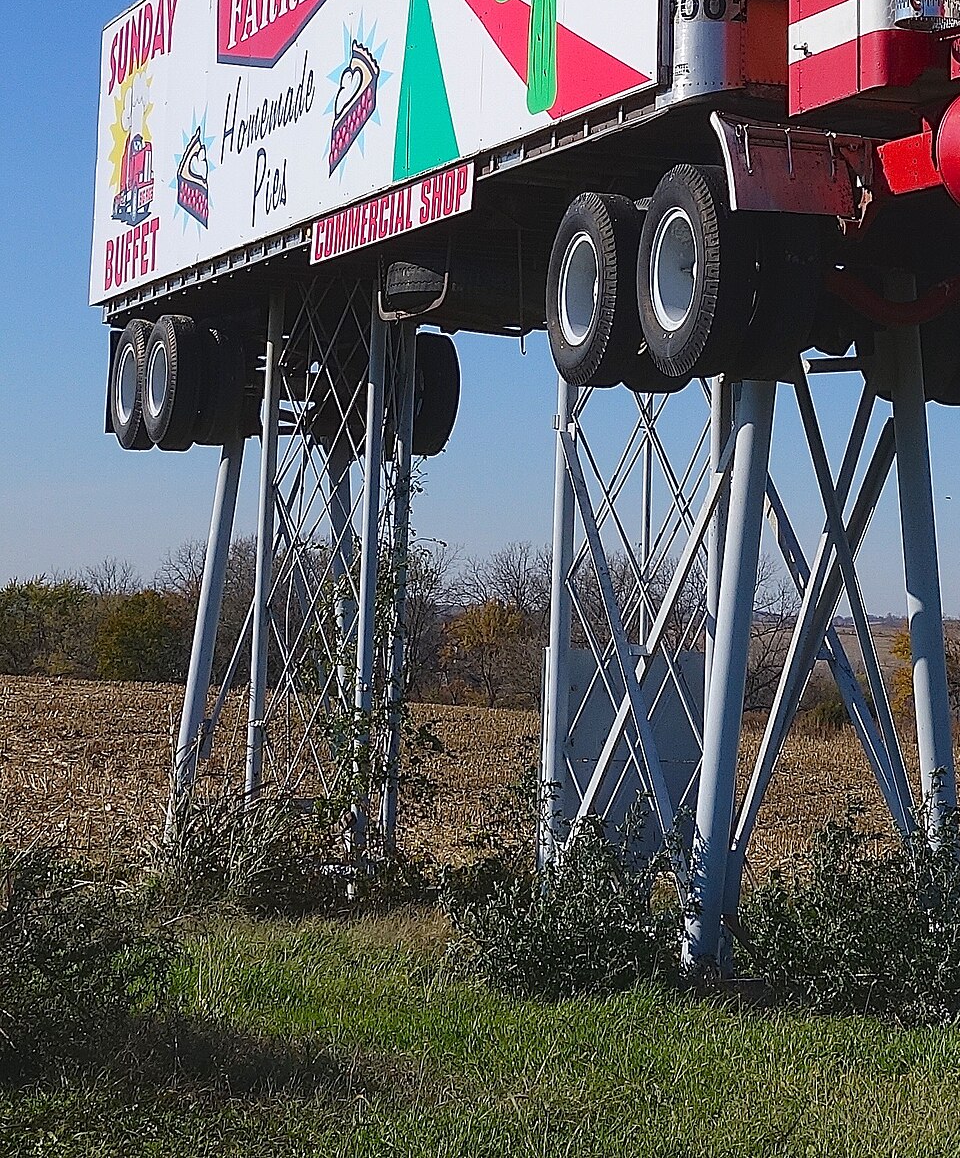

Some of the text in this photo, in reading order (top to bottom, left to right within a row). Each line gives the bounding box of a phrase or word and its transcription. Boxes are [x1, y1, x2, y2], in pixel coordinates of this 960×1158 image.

[220, 49, 316, 165] Homemade
[251, 148, 288, 228] Pies
[314, 165, 468, 261] COMMERCIAL SHOP
[103, 216, 160, 291] BUFFET
